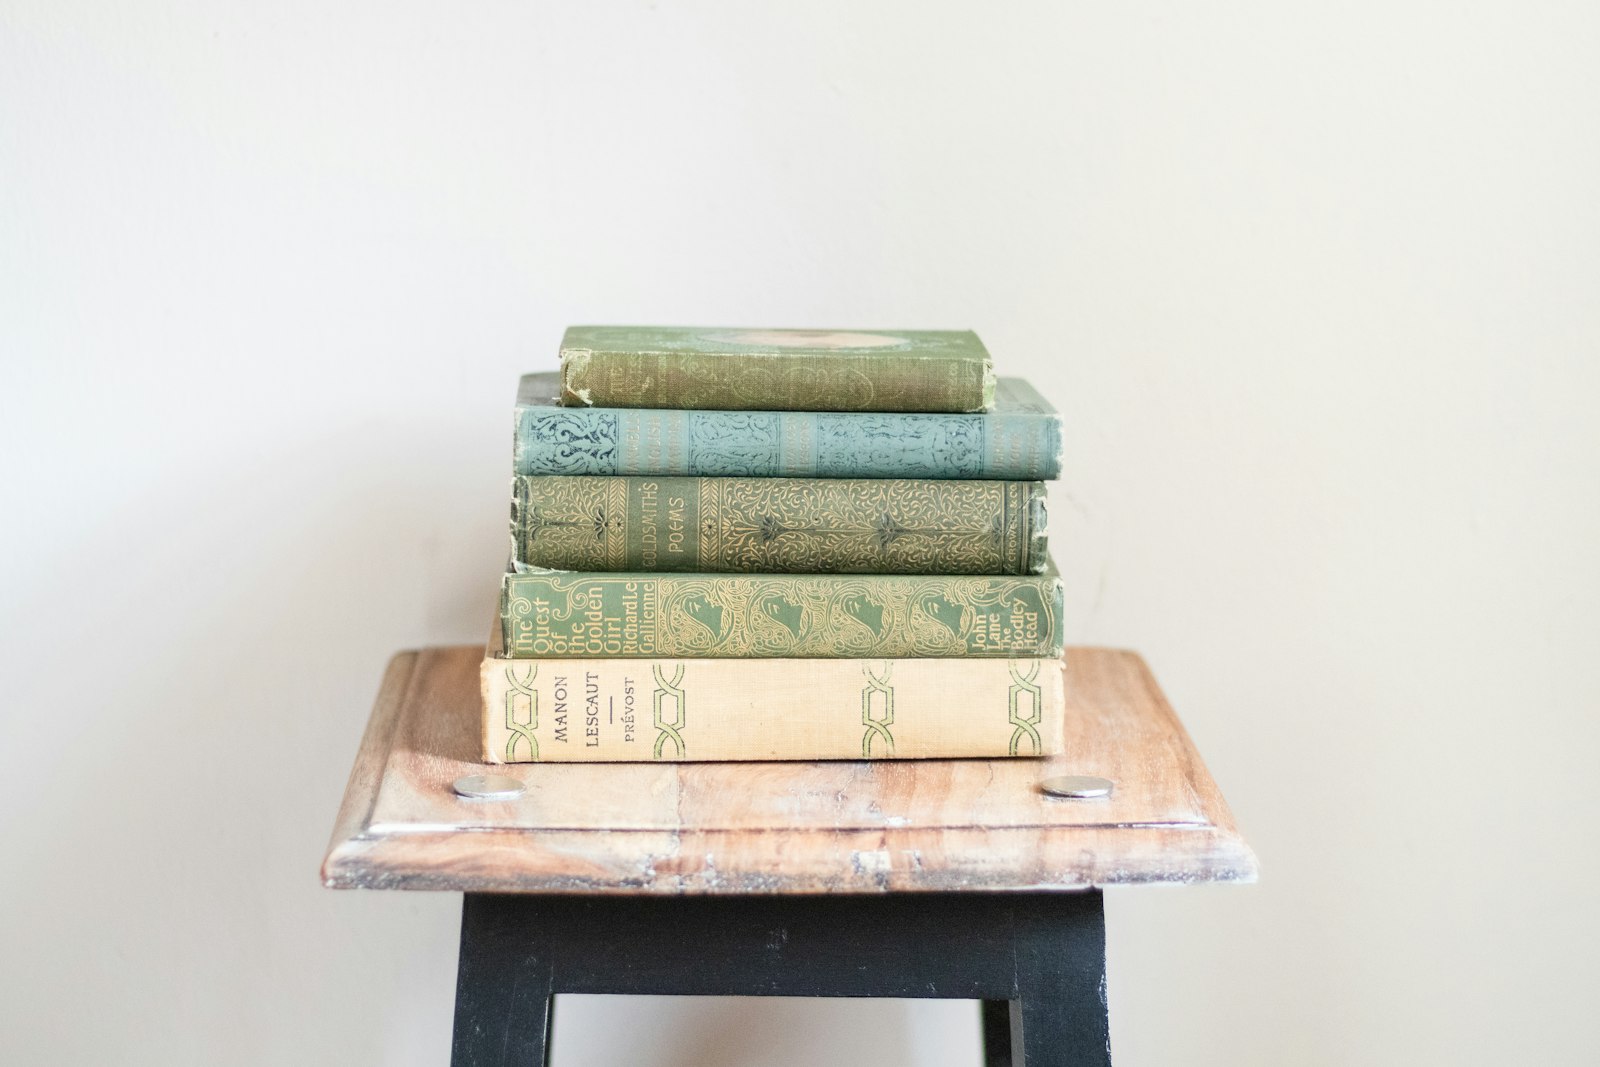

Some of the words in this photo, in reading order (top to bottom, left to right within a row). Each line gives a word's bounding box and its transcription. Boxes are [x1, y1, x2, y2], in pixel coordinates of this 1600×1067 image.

[668, 496, 684, 553] POEMS
[516, 620, 533, 651] The
[533, 597, 555, 654] Quest
[568, 622, 586, 654] the
[585, 586, 603, 654] Golden
[603, 616, 622, 654] Girl
[639, 582, 655, 654] Gallienne
[972, 614, 987, 651] John
[986, 612, 1001, 650] Lane
[1000, 627, 1012, 650] The
[1010, 597, 1028, 650] Bodley
[1024, 611, 1039, 650] Head
[554, 676, 568, 744] MANON
[585, 671, 599, 747] LESCAUT
[620, 677, 635, 742] PRÉVOST
